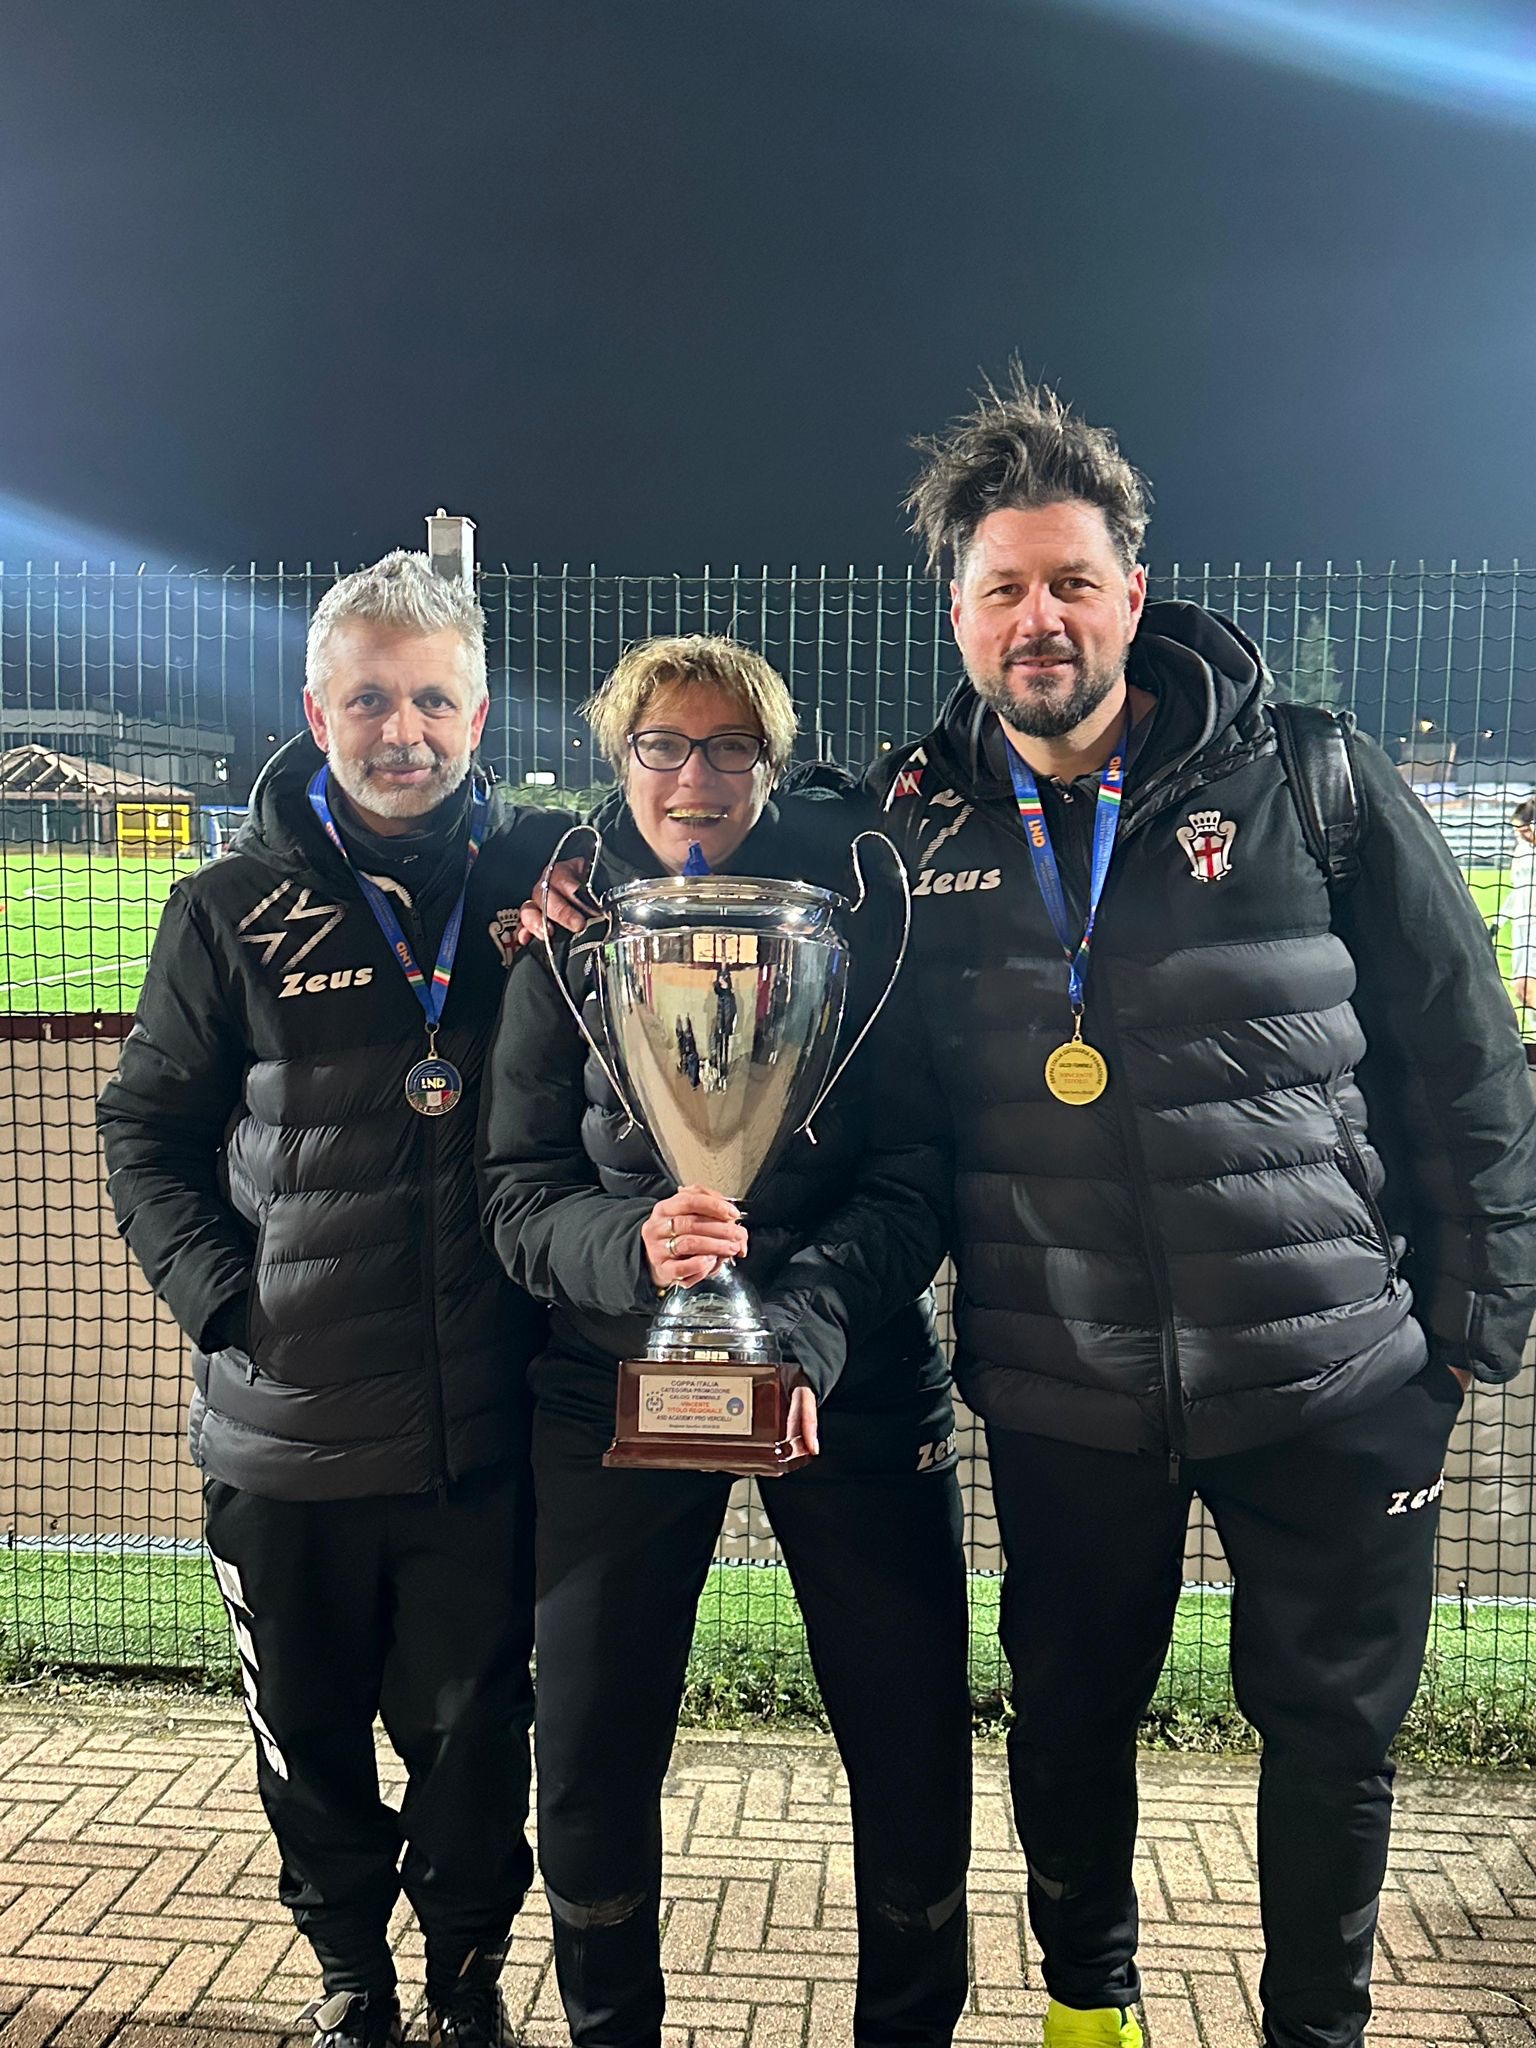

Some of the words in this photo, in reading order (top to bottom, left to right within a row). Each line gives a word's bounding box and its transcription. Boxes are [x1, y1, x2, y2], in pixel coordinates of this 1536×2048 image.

[1028, 819, 1046, 847] LND
[911, 868, 1001, 896] Zeus
[278, 967, 373, 998] Zeus
[421, 1077, 447, 1089] LND
[916, 1428, 956, 1471] Zeu
